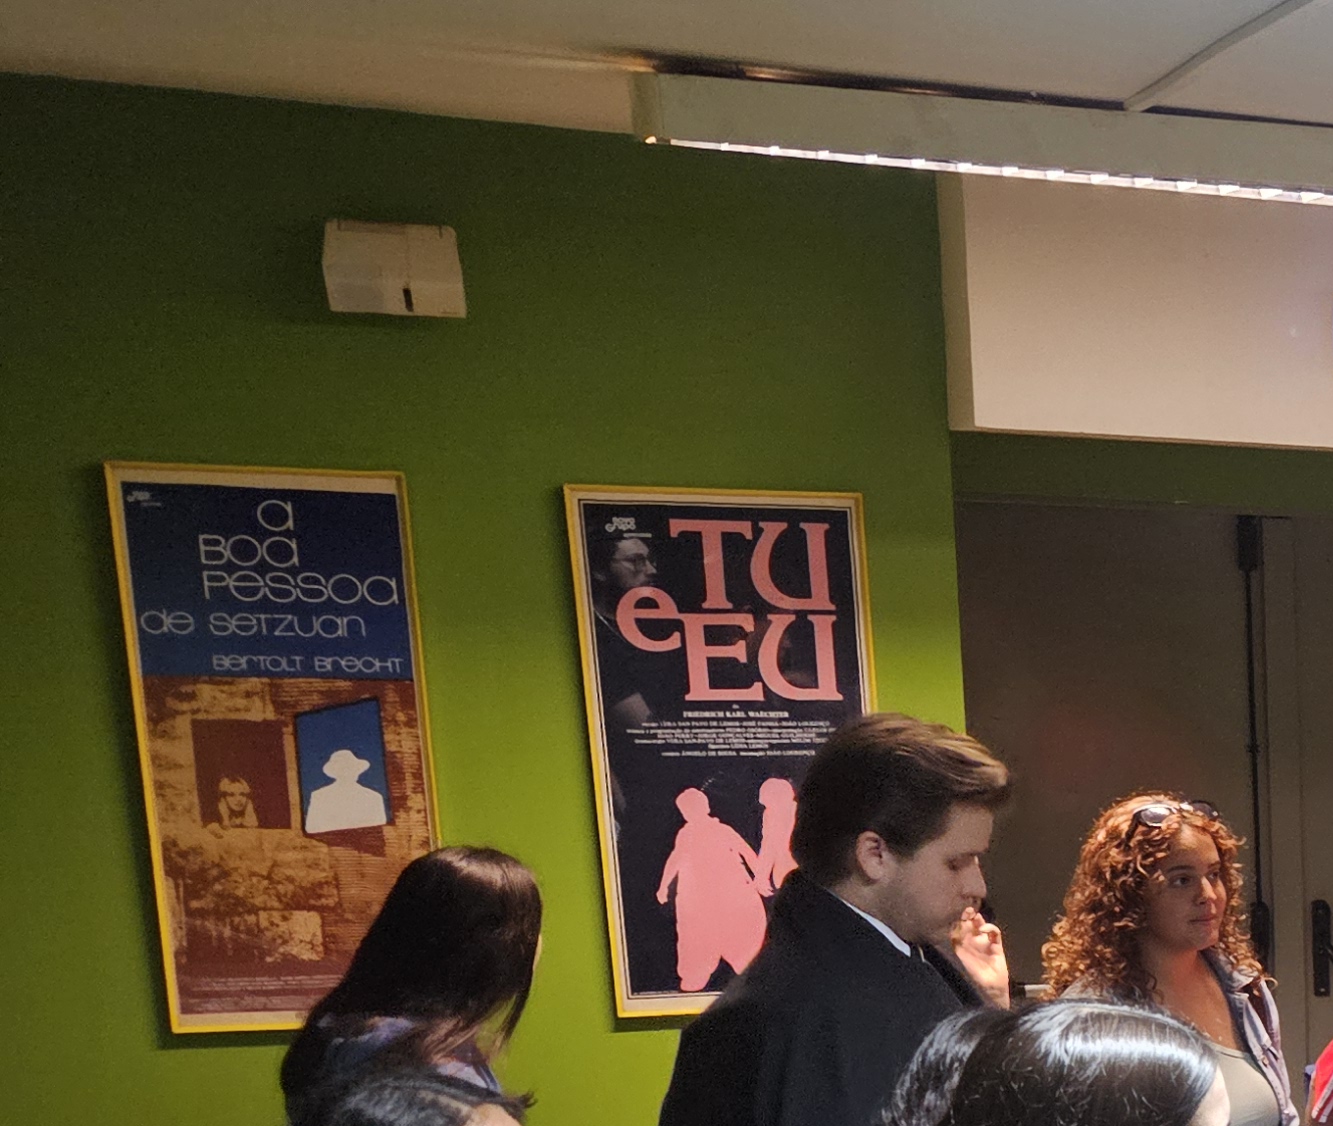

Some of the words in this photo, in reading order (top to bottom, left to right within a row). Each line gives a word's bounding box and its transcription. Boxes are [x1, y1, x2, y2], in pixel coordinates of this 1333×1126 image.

[256, 499, 295, 531] a
[668, 518, 837, 611] TU
[140, 608, 195, 635] de
[616, 586, 682, 652] e
[679, 612, 844, 701] EU
